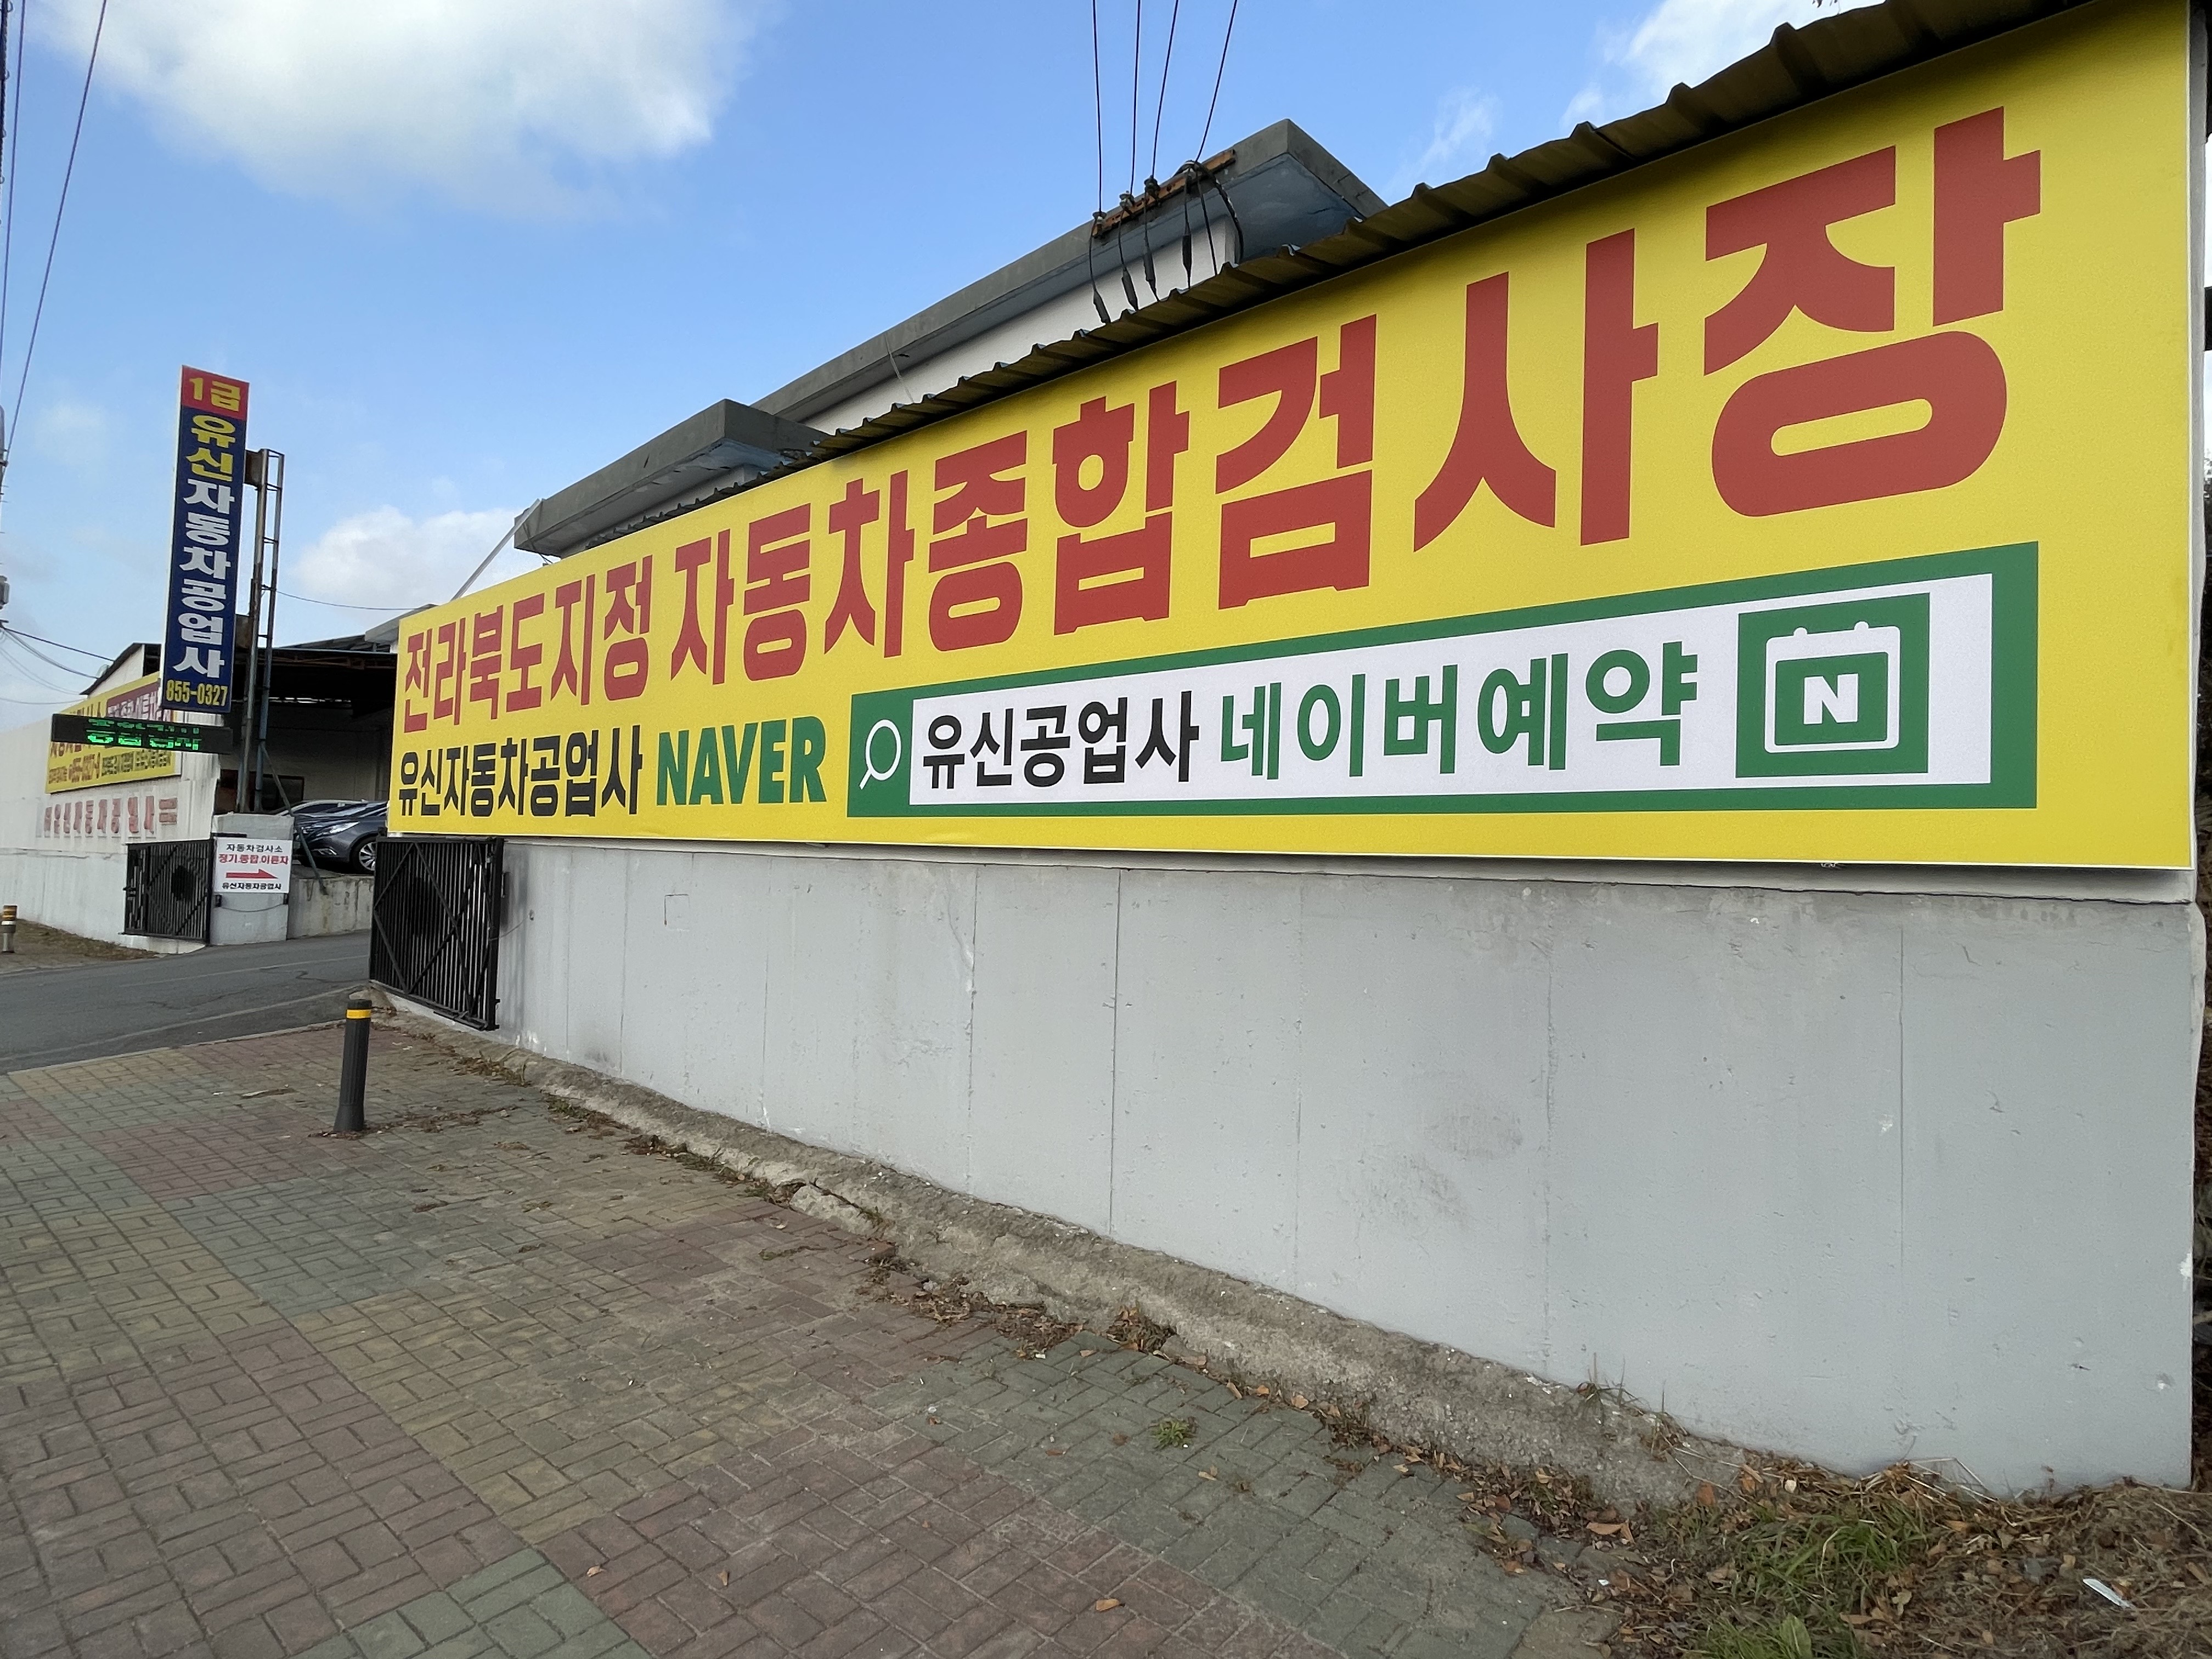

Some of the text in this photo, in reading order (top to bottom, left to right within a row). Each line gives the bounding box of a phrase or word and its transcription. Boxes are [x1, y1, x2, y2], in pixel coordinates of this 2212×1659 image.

[189, 377, 240, 412] 1급
[404, 106, 2041, 733] 전라북도지정 자동차종합검사장
[166, 679, 228, 707] 855-0327
[922, 641, 1699, 789] 유신공업사 네이버예약
[1803, 673, 1859, 725] N
[399, 716, 826, 817] 유신자동차공업사 NAVER
[226, 844, 283, 853] 자동차검사소
